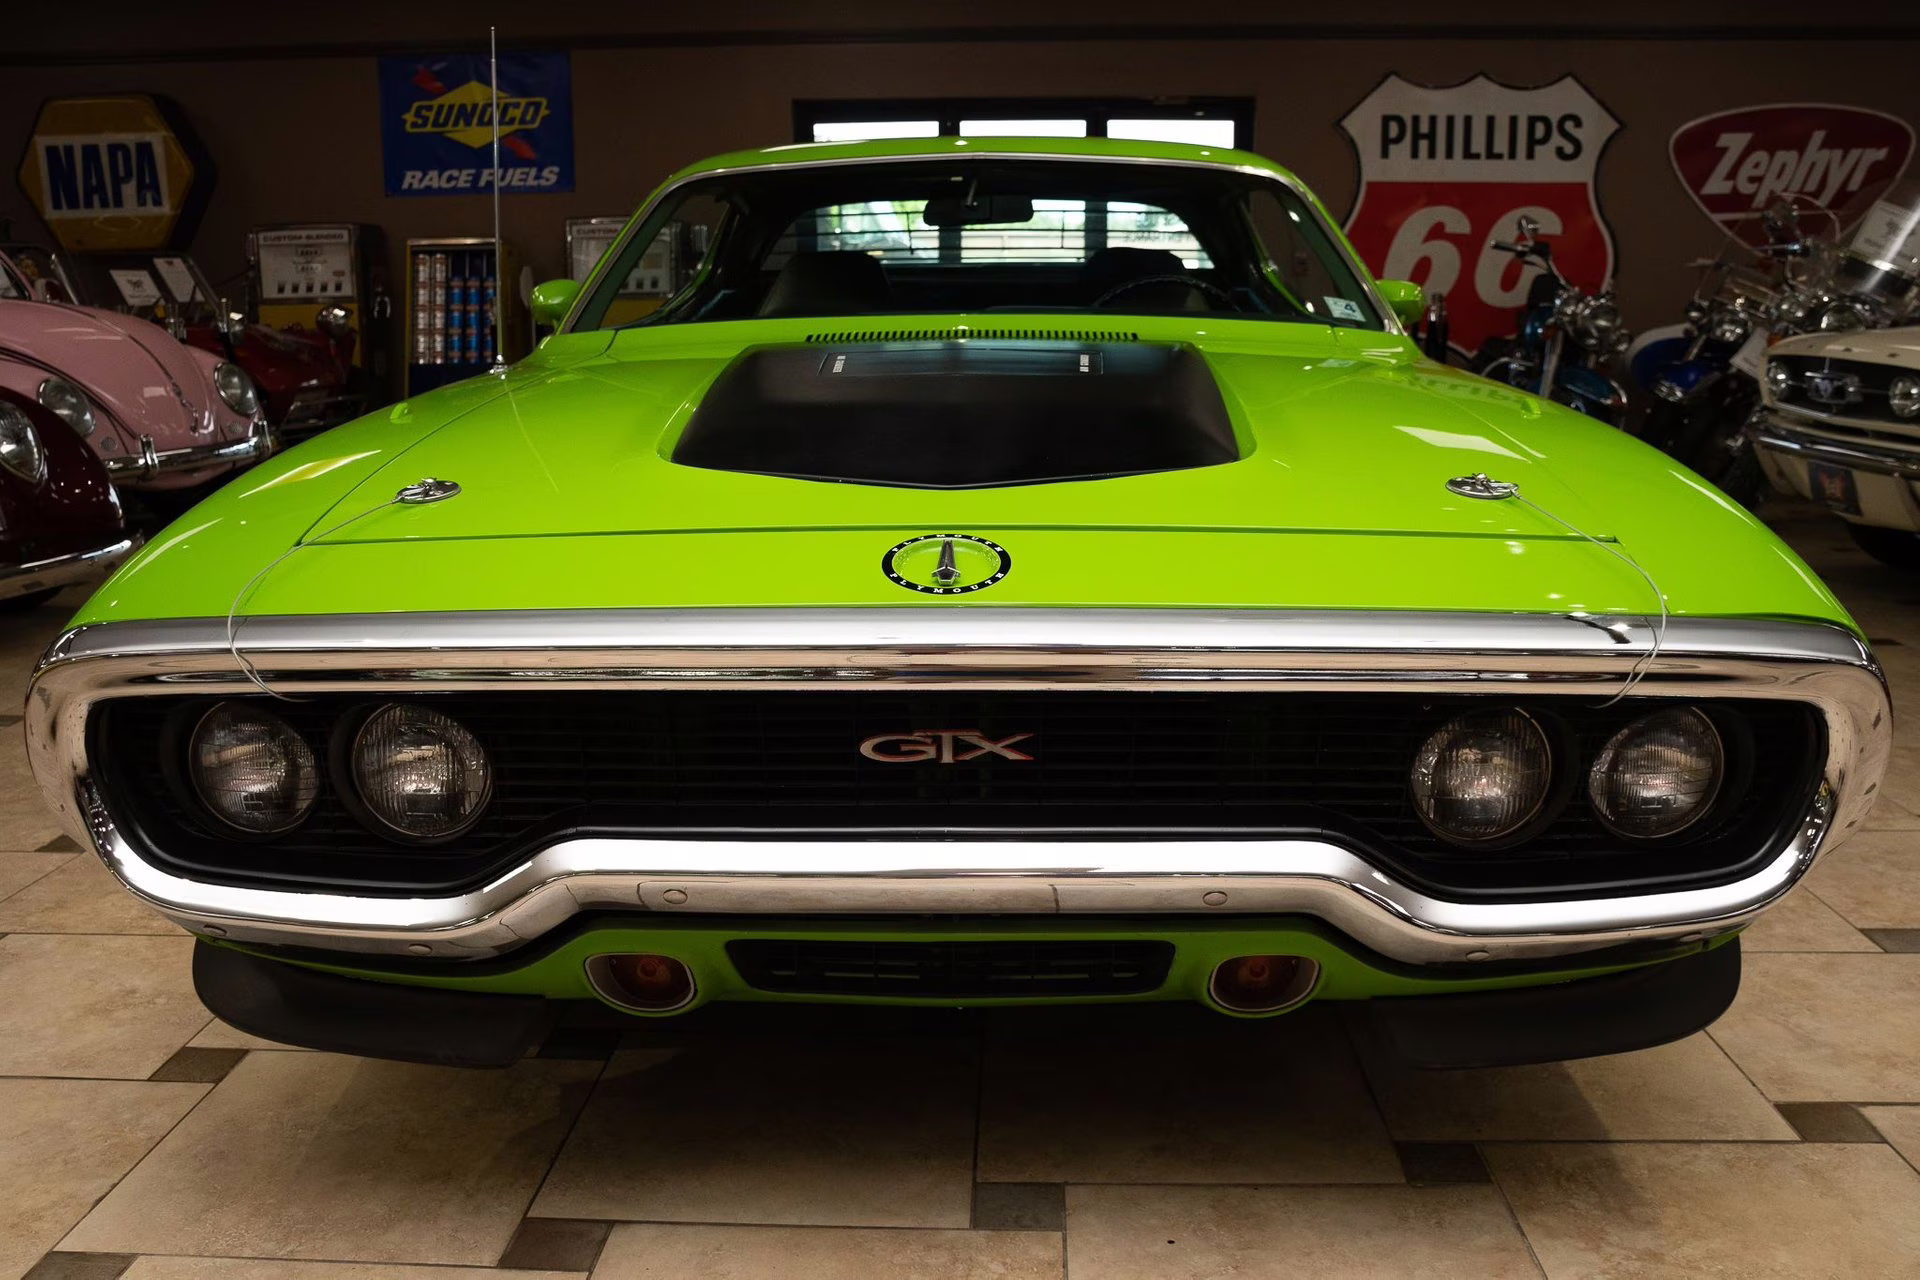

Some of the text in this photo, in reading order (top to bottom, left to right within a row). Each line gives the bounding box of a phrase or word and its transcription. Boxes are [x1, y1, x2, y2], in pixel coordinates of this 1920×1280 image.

[410, 101, 543, 128] SUNOCO
[1380, 113, 1584, 161] PHILLIPS
[45, 141, 163, 210] NAPA
[401, 166, 560, 189] RACE FUELS
[1700, 130, 1890, 208] Zephyr
[1382, 205, 1563, 308] 66
[891, 534, 1003, 552] PLYMOUTH
[890, 573, 1005, 593] PLYMOUTH
[859, 729, 1034, 763] GTX
